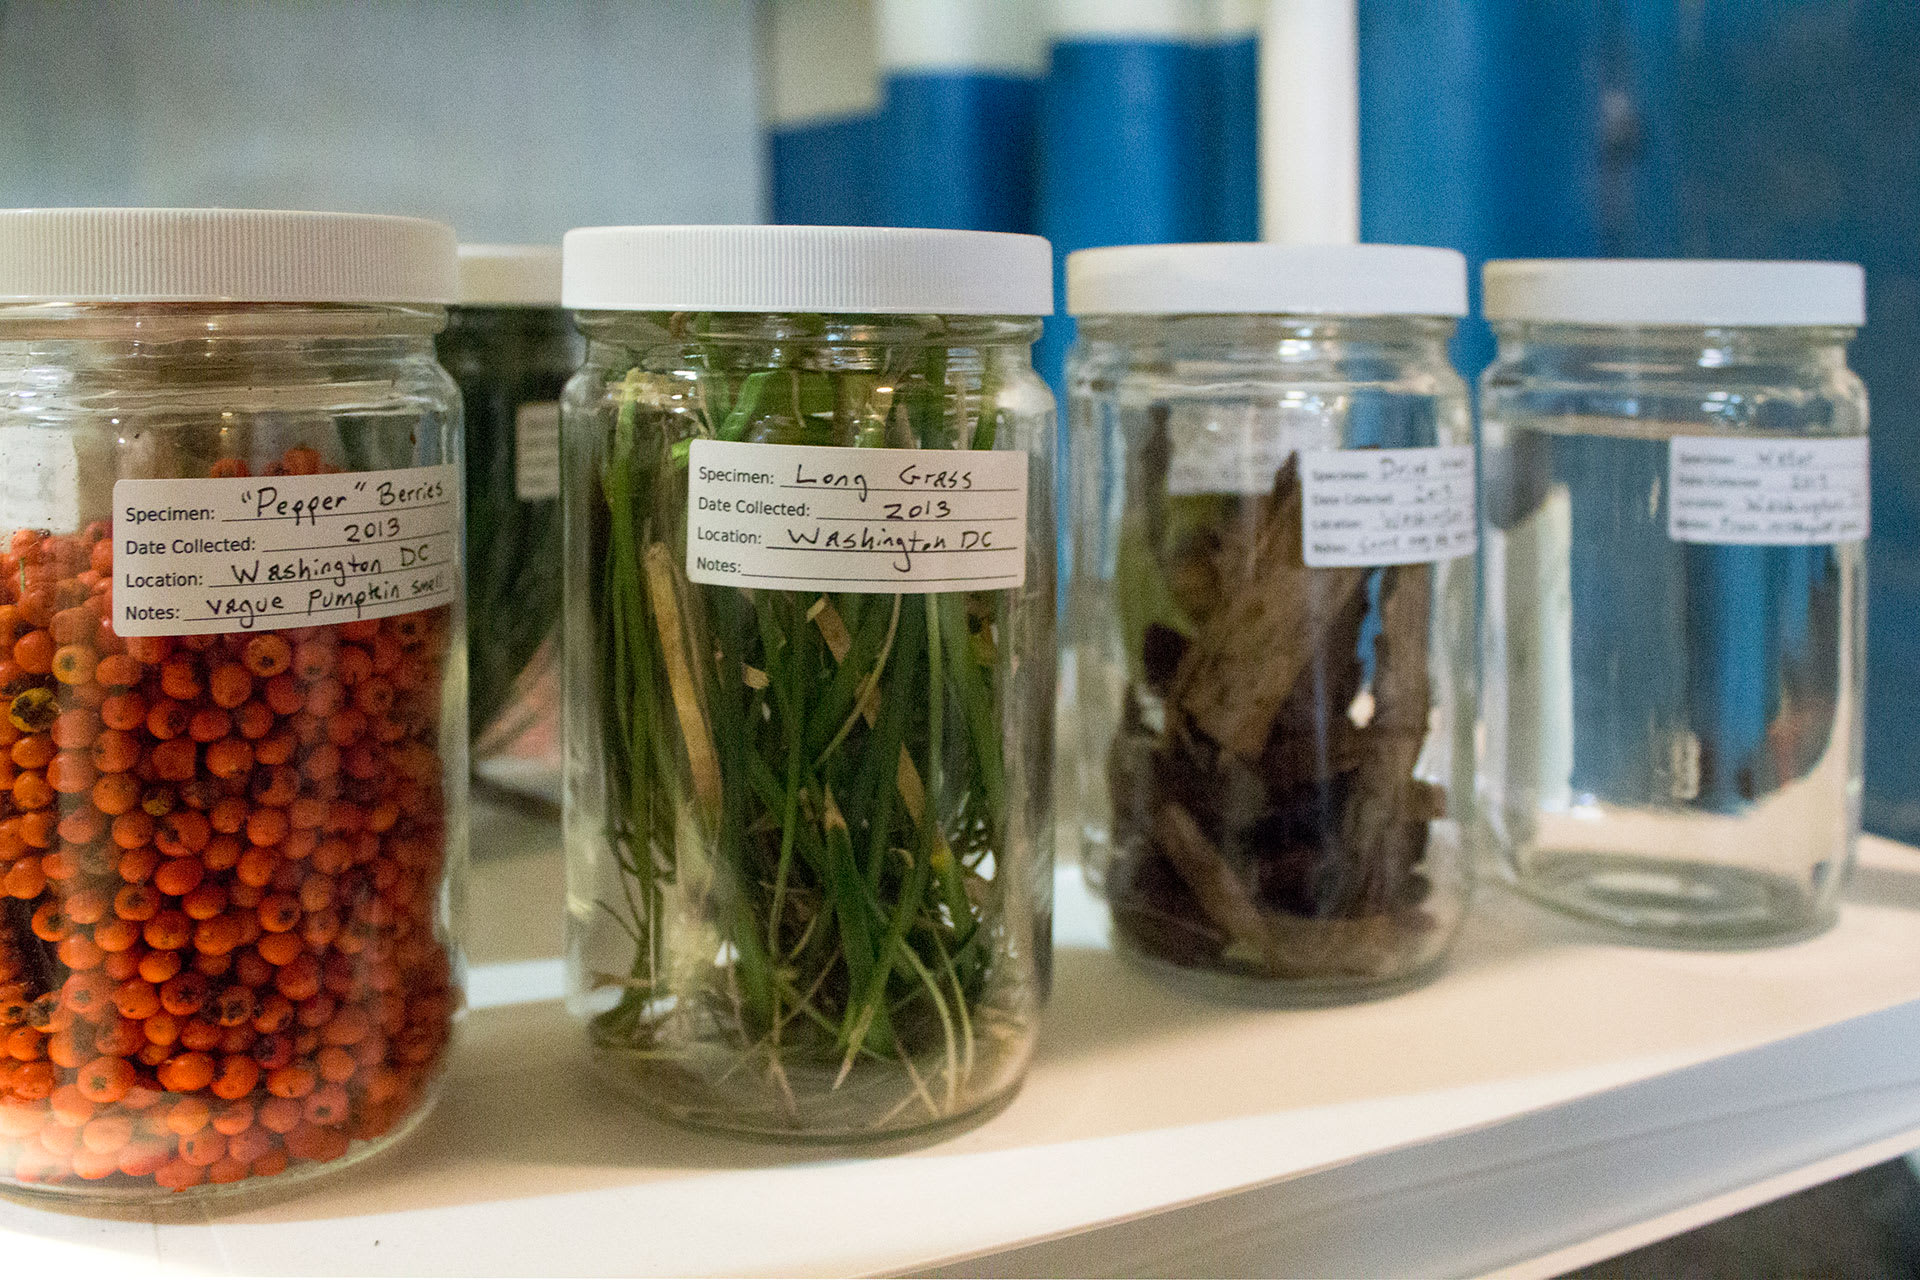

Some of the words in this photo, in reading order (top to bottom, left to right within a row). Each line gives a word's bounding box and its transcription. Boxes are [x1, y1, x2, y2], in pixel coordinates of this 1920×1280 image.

[699, 466, 775, 484] Specimen:
[796, 464, 868, 502] Long
[899, 465, 972, 490] Grass
[126, 507, 215, 525] Specimen:
[376, 481, 444, 506] Berries
[698, 497, 732, 513] Date
[735, 499, 810, 517] Collected:
[884, 500, 952, 521] 2013
[126, 540, 167, 555] Date
[171, 536, 256, 554] Collected:
[344, 517, 401, 543] 2013
[697, 527, 762, 545] Location:
[787, 527, 946, 573] Washington
[960, 531, 992, 550] DC
[126, 572, 203, 588] Location:
[231, 554, 382, 588] Washington
[400, 544, 430, 567] DC
[697, 557, 742, 574] Notes:
[126, 606, 180, 621] Notes:
